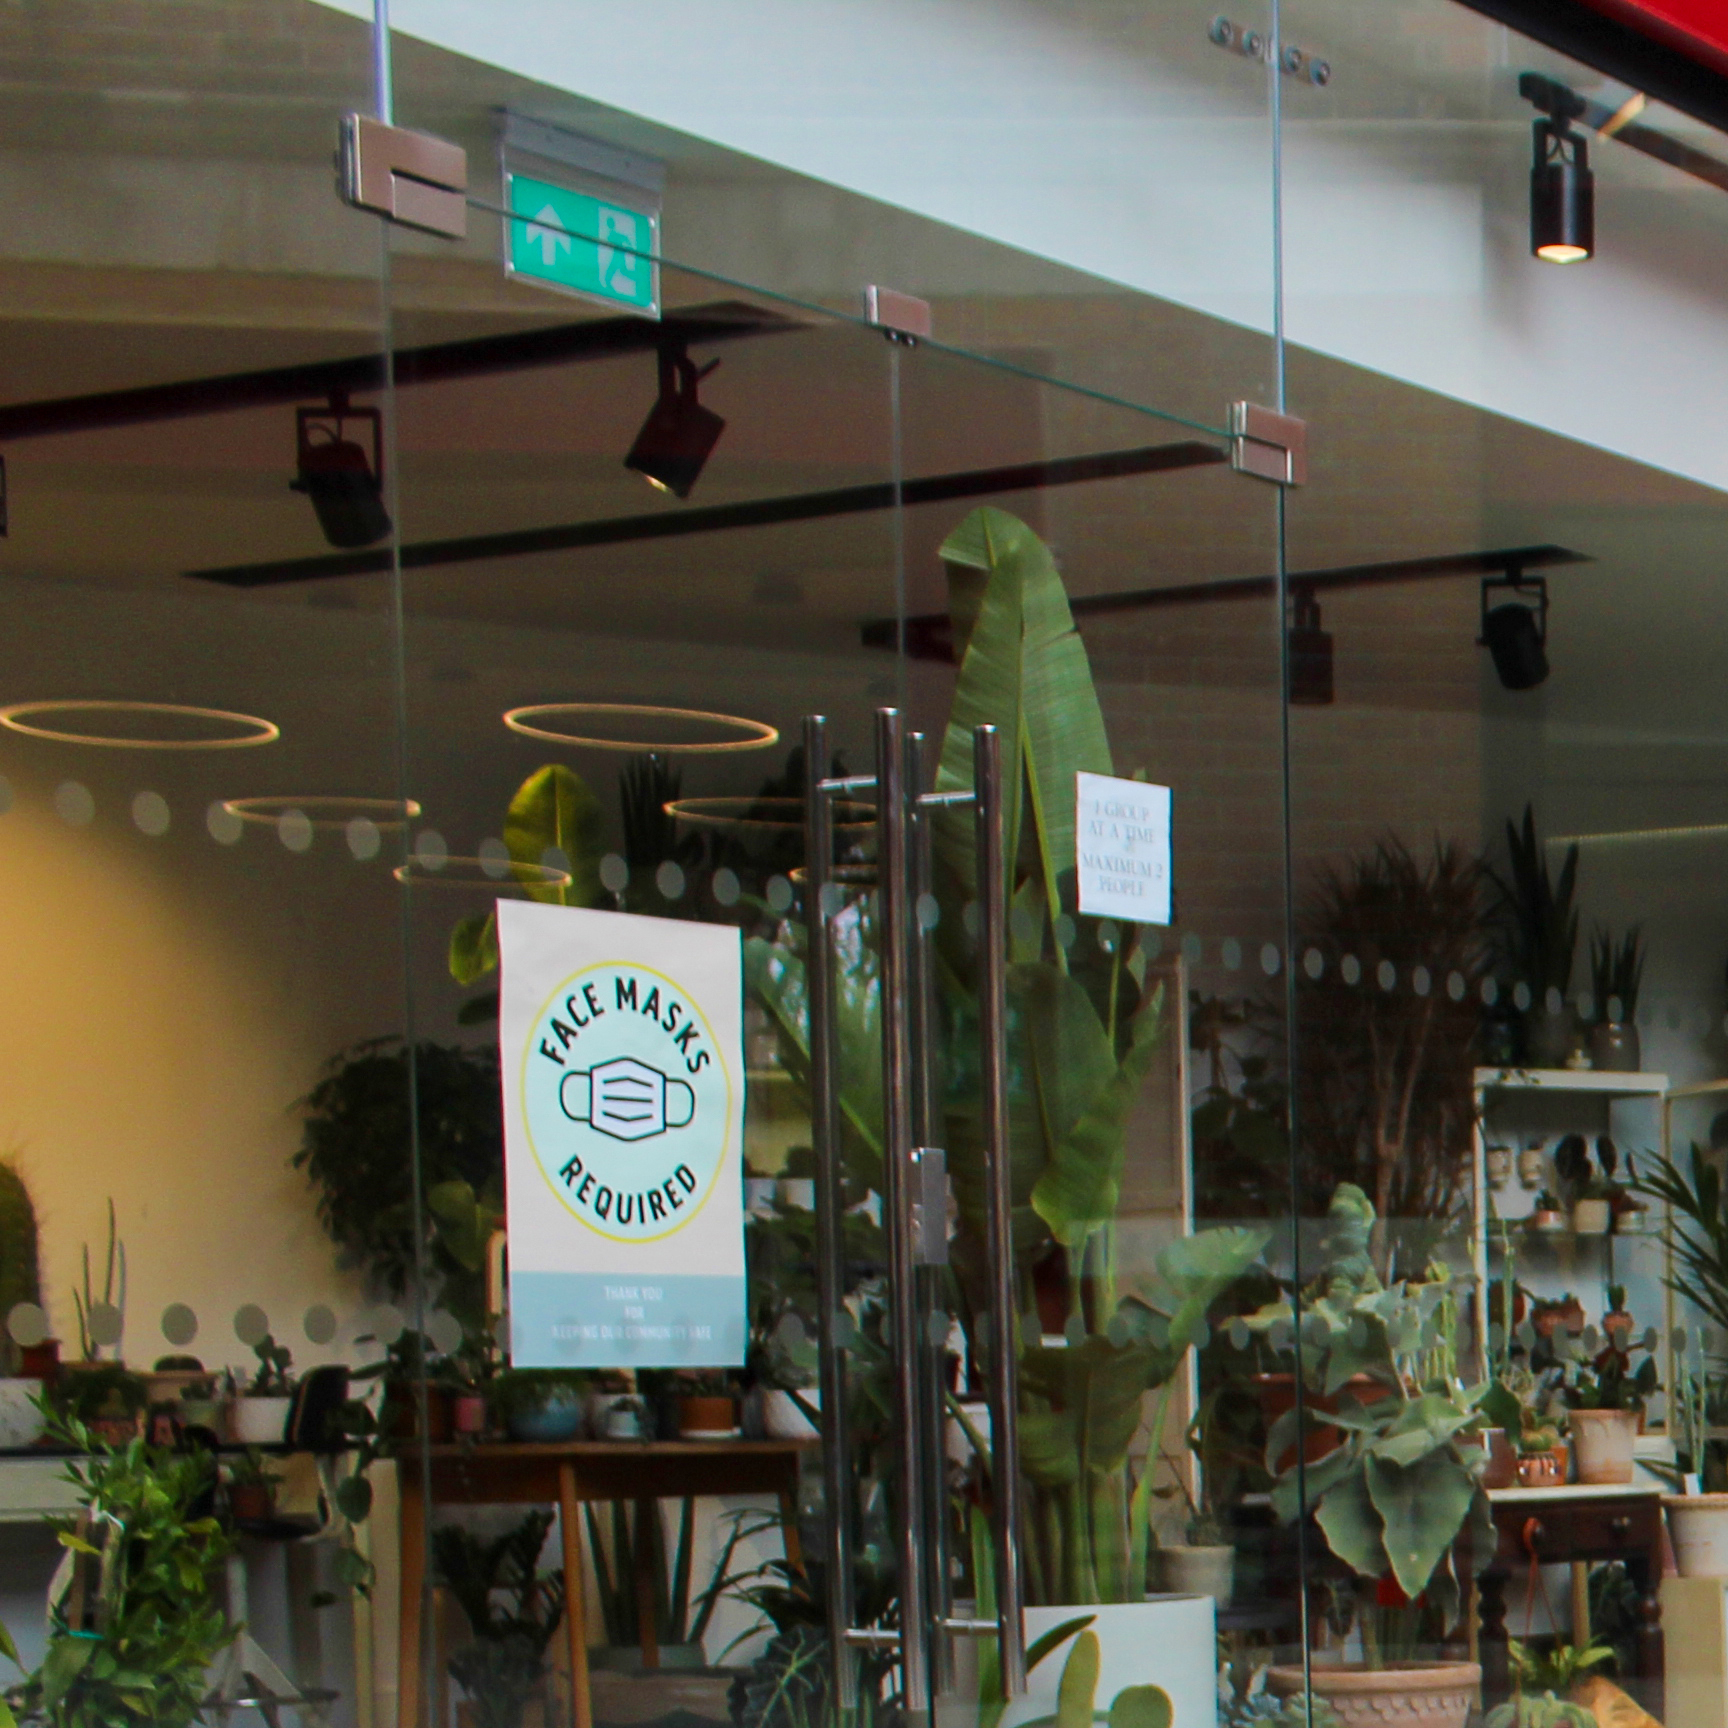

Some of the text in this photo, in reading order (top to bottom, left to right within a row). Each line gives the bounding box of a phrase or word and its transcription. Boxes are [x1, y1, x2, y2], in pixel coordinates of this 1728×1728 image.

[1105, 802, 1149, 820] GROUP
[1089, 820, 1153, 843] AT A TIME
[1082, 852, 1151, 877] MAXIMUM
[1098, 875, 1144, 896] PEOPLE
[539, 976, 711, 1076] FACE MASKS
[558, 1154, 698, 1225] REQUIRED
[604, 1285, 664, 1300] THANK YOU
